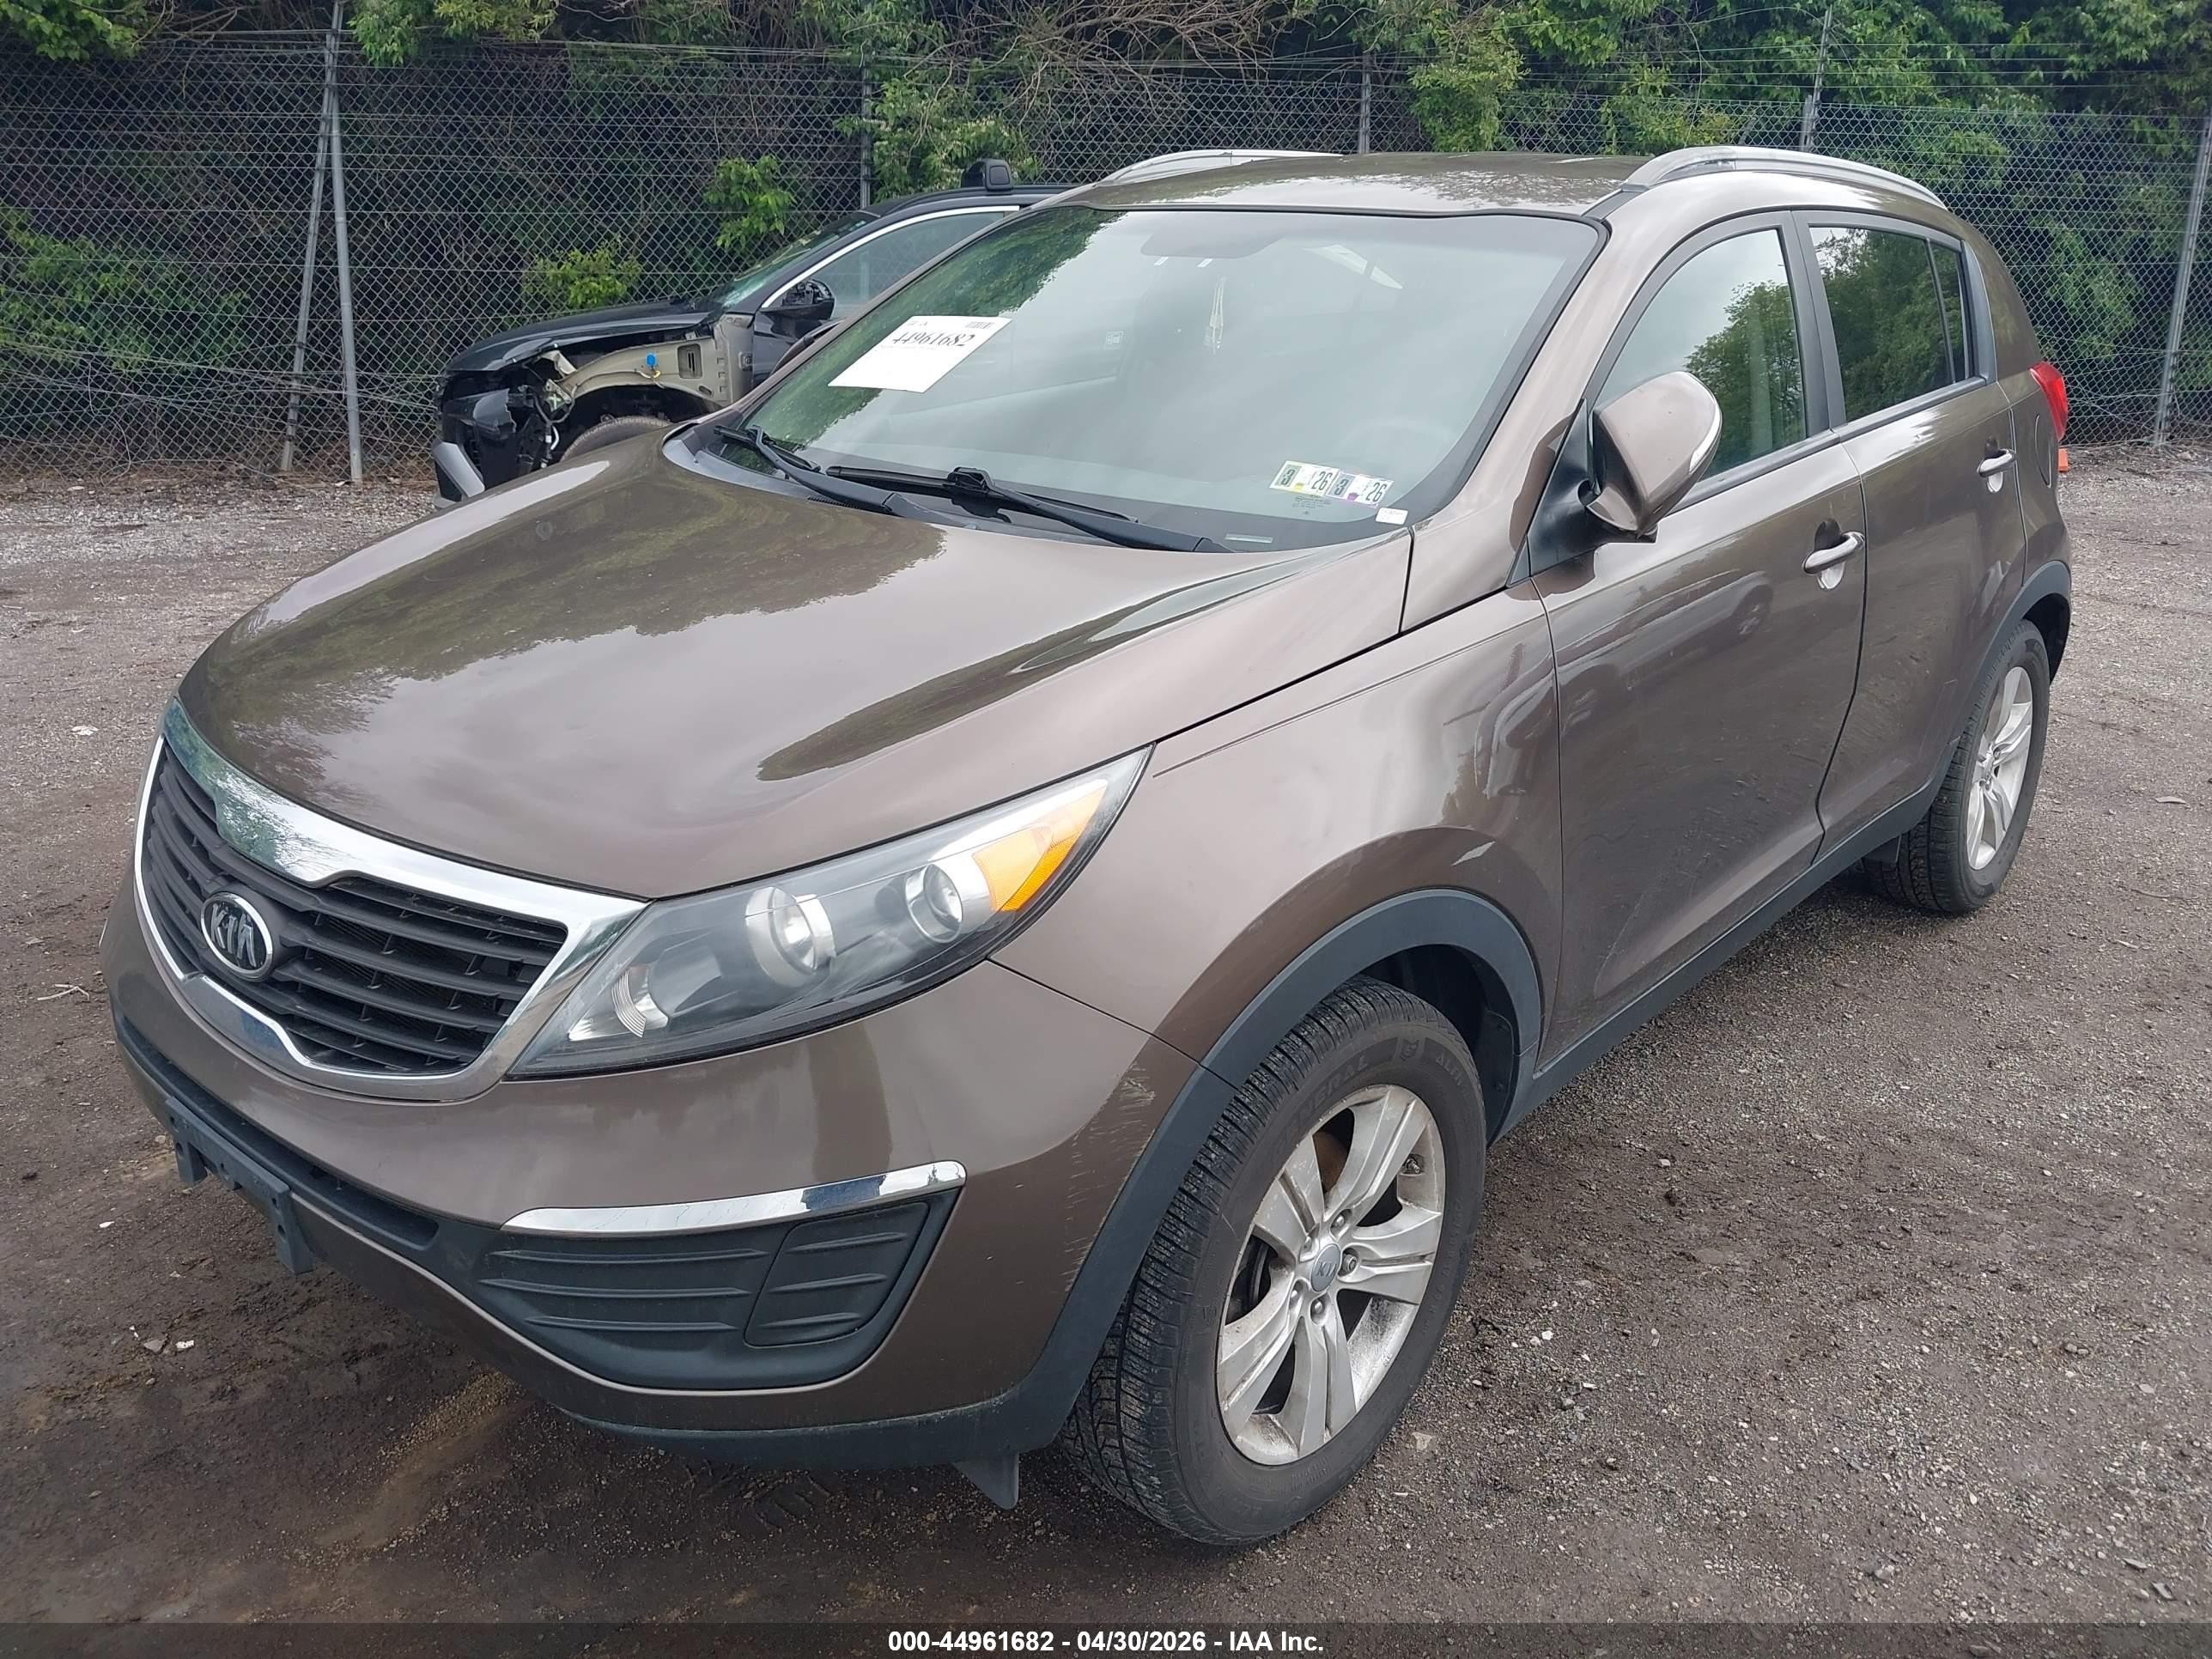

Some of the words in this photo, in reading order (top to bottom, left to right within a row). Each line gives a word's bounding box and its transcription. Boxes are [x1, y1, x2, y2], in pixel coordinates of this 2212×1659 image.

[892, 331, 975, 347] 44961682
[1280, 469, 1296, 486] 3
[1311, 471, 1334, 490] 26
[1334, 478, 1349, 495] 3
[1365, 482, 1388, 502] 26
[210, 902, 257, 968] KIA
